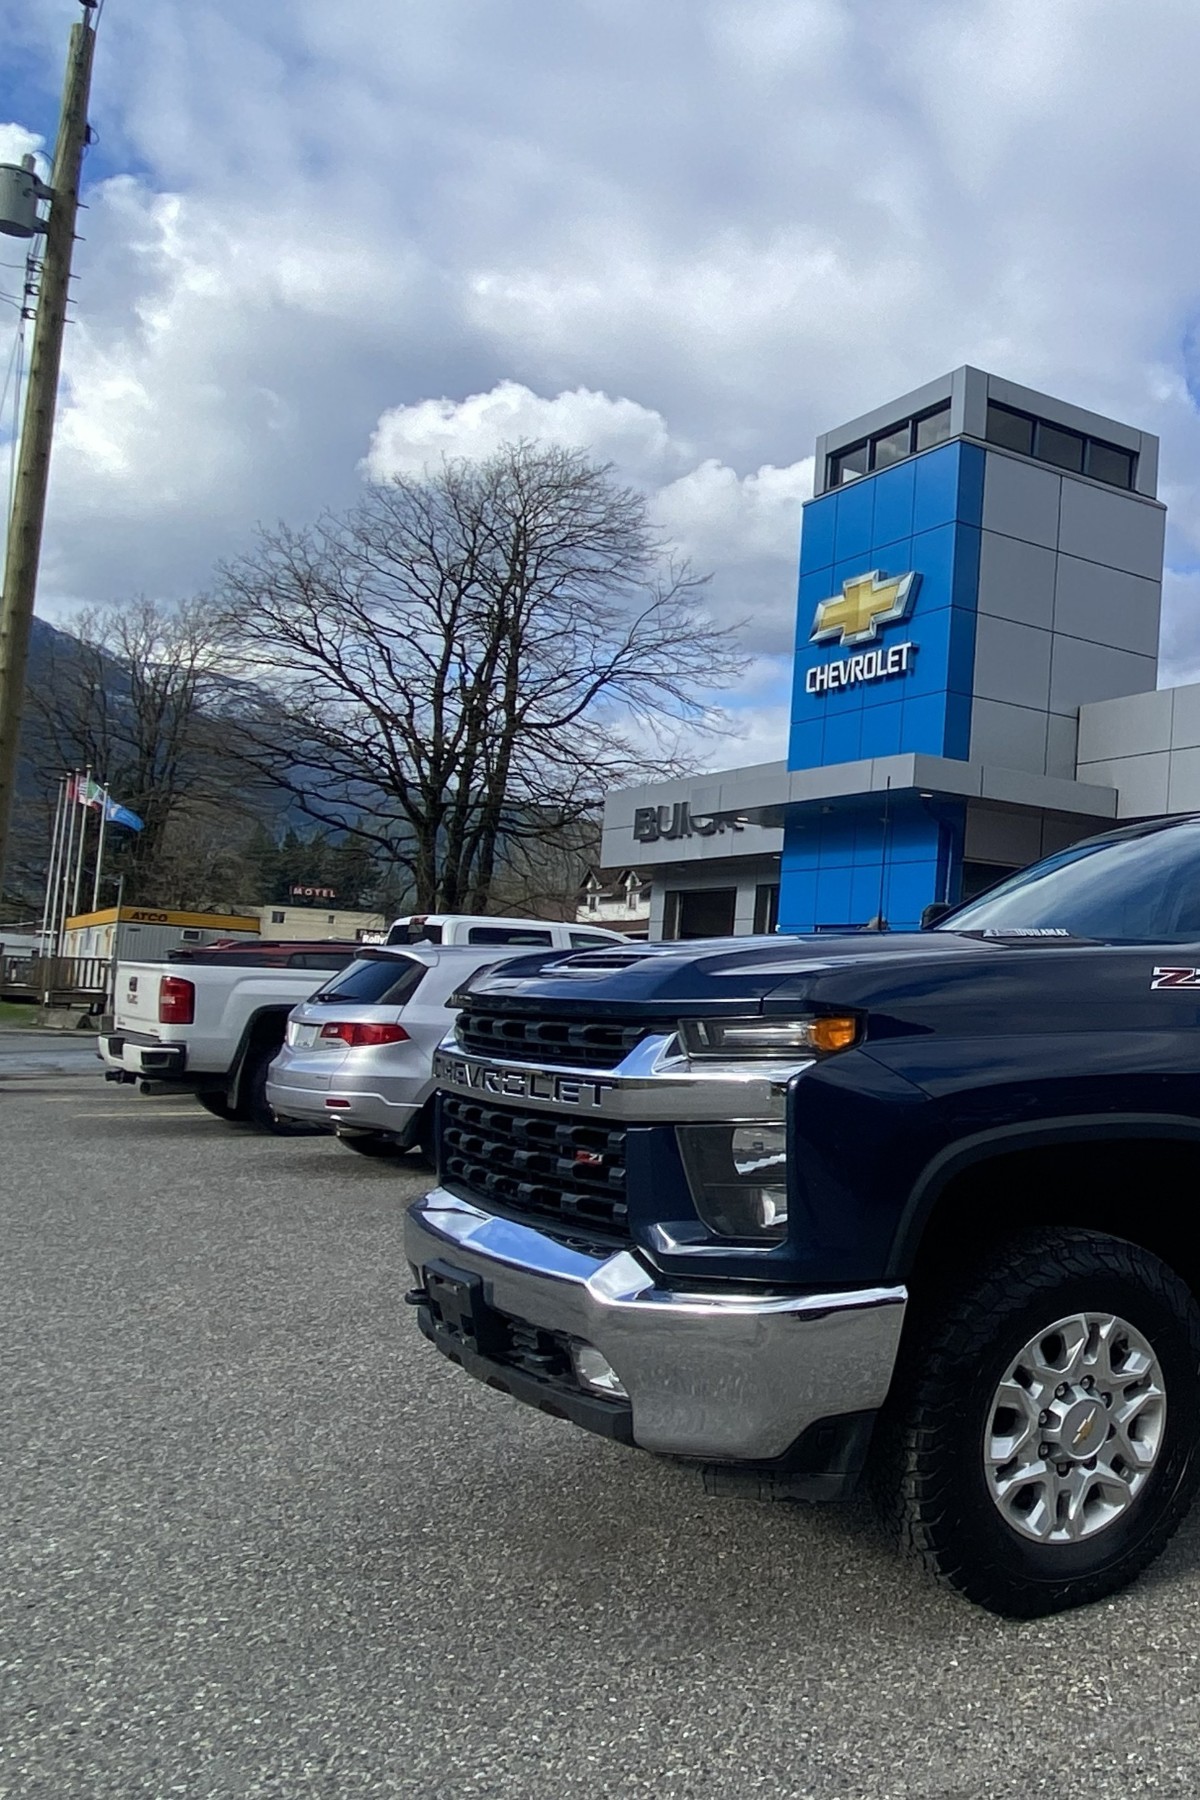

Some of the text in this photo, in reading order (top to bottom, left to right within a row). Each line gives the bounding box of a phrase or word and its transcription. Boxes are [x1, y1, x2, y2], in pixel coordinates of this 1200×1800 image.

[805, 641, 913, 693] CHEVROLET
[293, 886, 335, 898] MOTEL
[130, 911, 168, 923] ATCO
[433, 1057, 613, 1107] CHEVROLET
